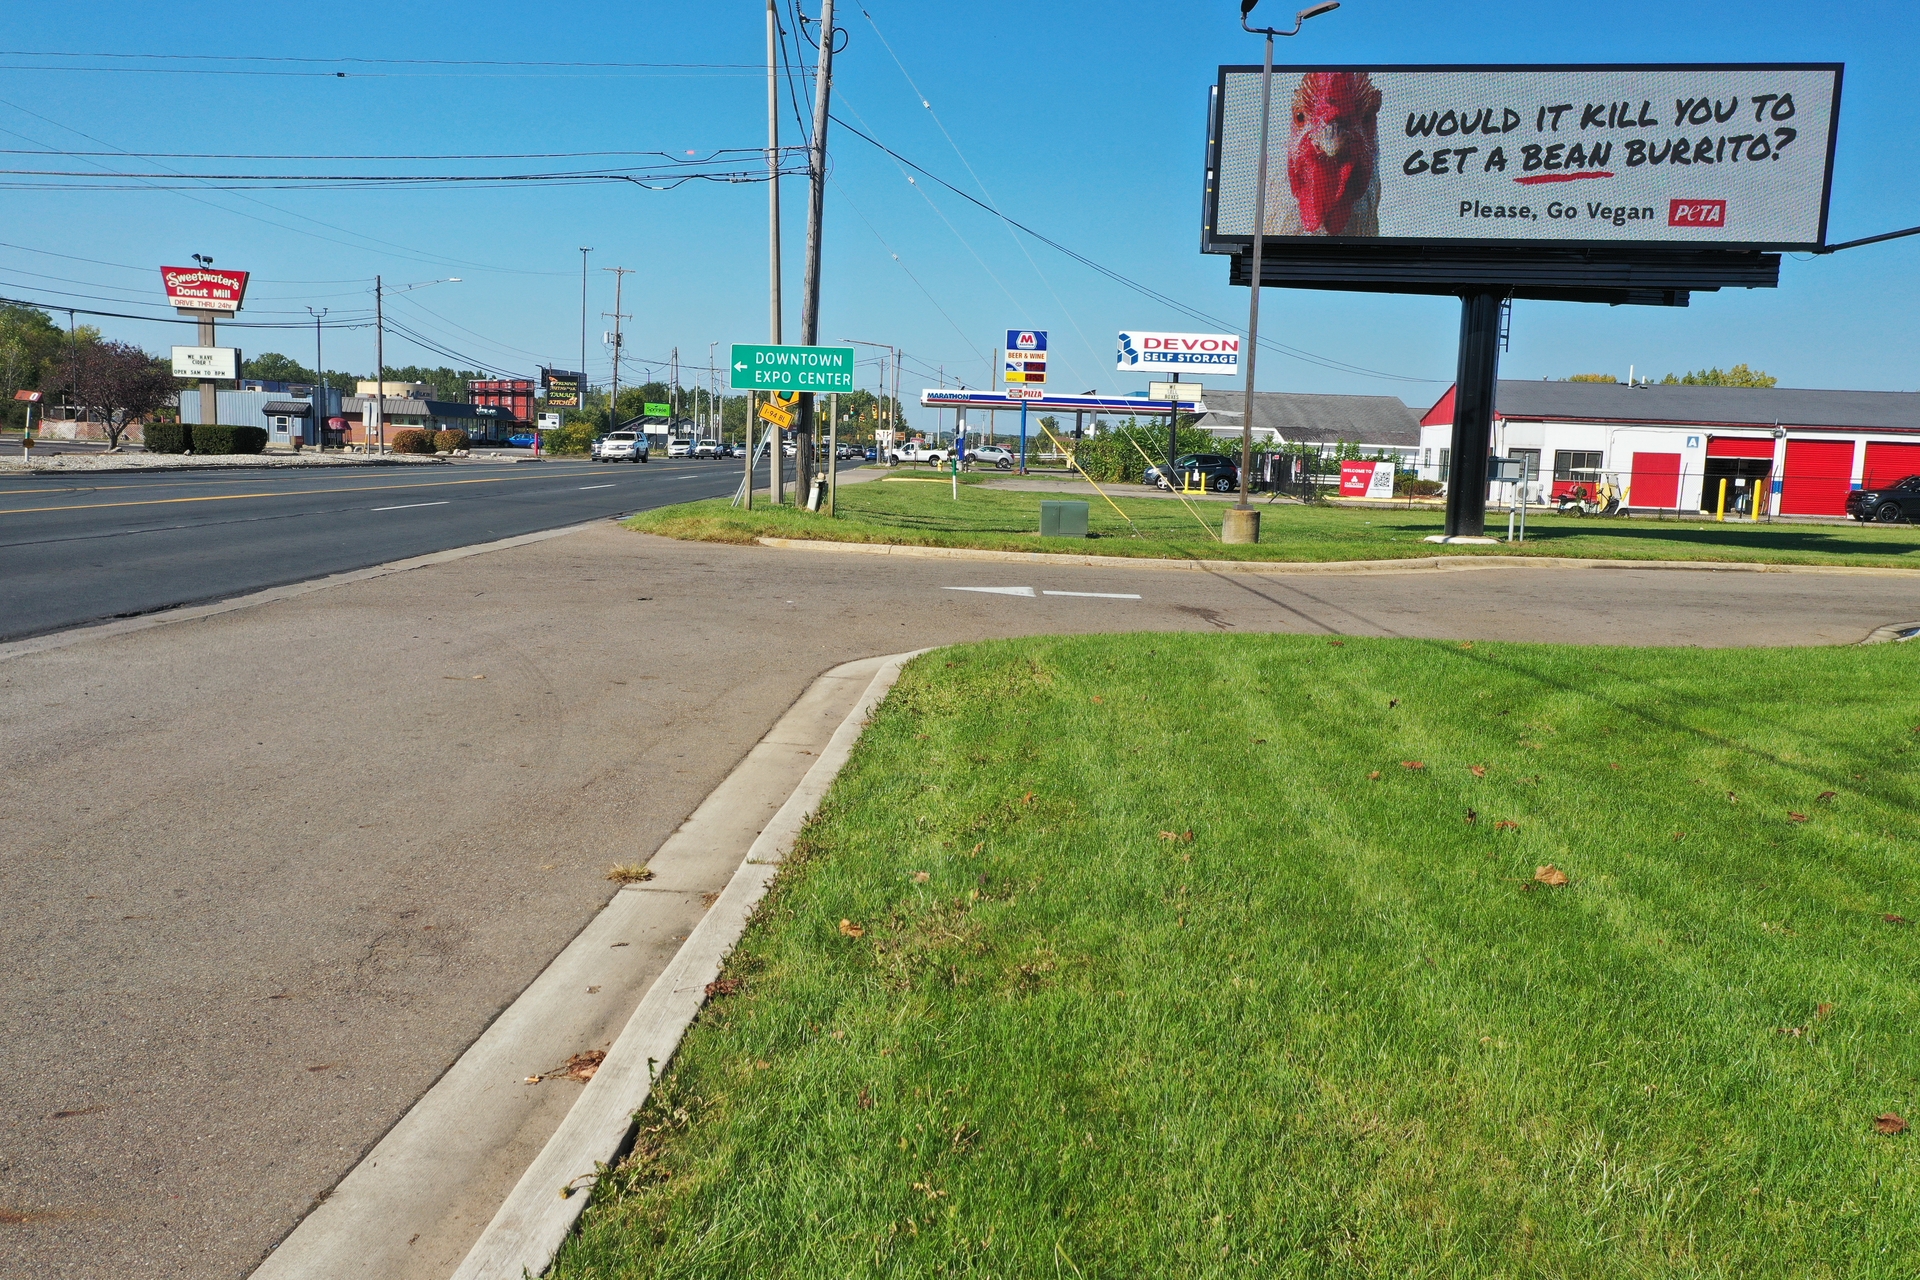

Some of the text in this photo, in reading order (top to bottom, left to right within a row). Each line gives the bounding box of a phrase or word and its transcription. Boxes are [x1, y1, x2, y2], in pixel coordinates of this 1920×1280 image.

[1405, 93, 1796, 137] WOULD IT KILL YOU TO
[1402, 127, 1798, 175] GET A BEAN BURRITO?
[1459, 201, 1538, 221] Please,
[1547, 201, 1578, 220] Go
[1587, 202, 1655, 226] Vegan
[166, 271, 239, 290] Sweetwater's
[176, 287, 230, 298] Donut Mill
[1144, 338, 1238, 351] DEVON
[755, 352, 843, 367] DOWNTOWN
[1145, 353, 1236, 363] SELF STORAGE
[755, 370, 851, 386] EXPO CENTER
[764, 409, 777, 418] I-94
[1688, 438, 1697, 447] A
